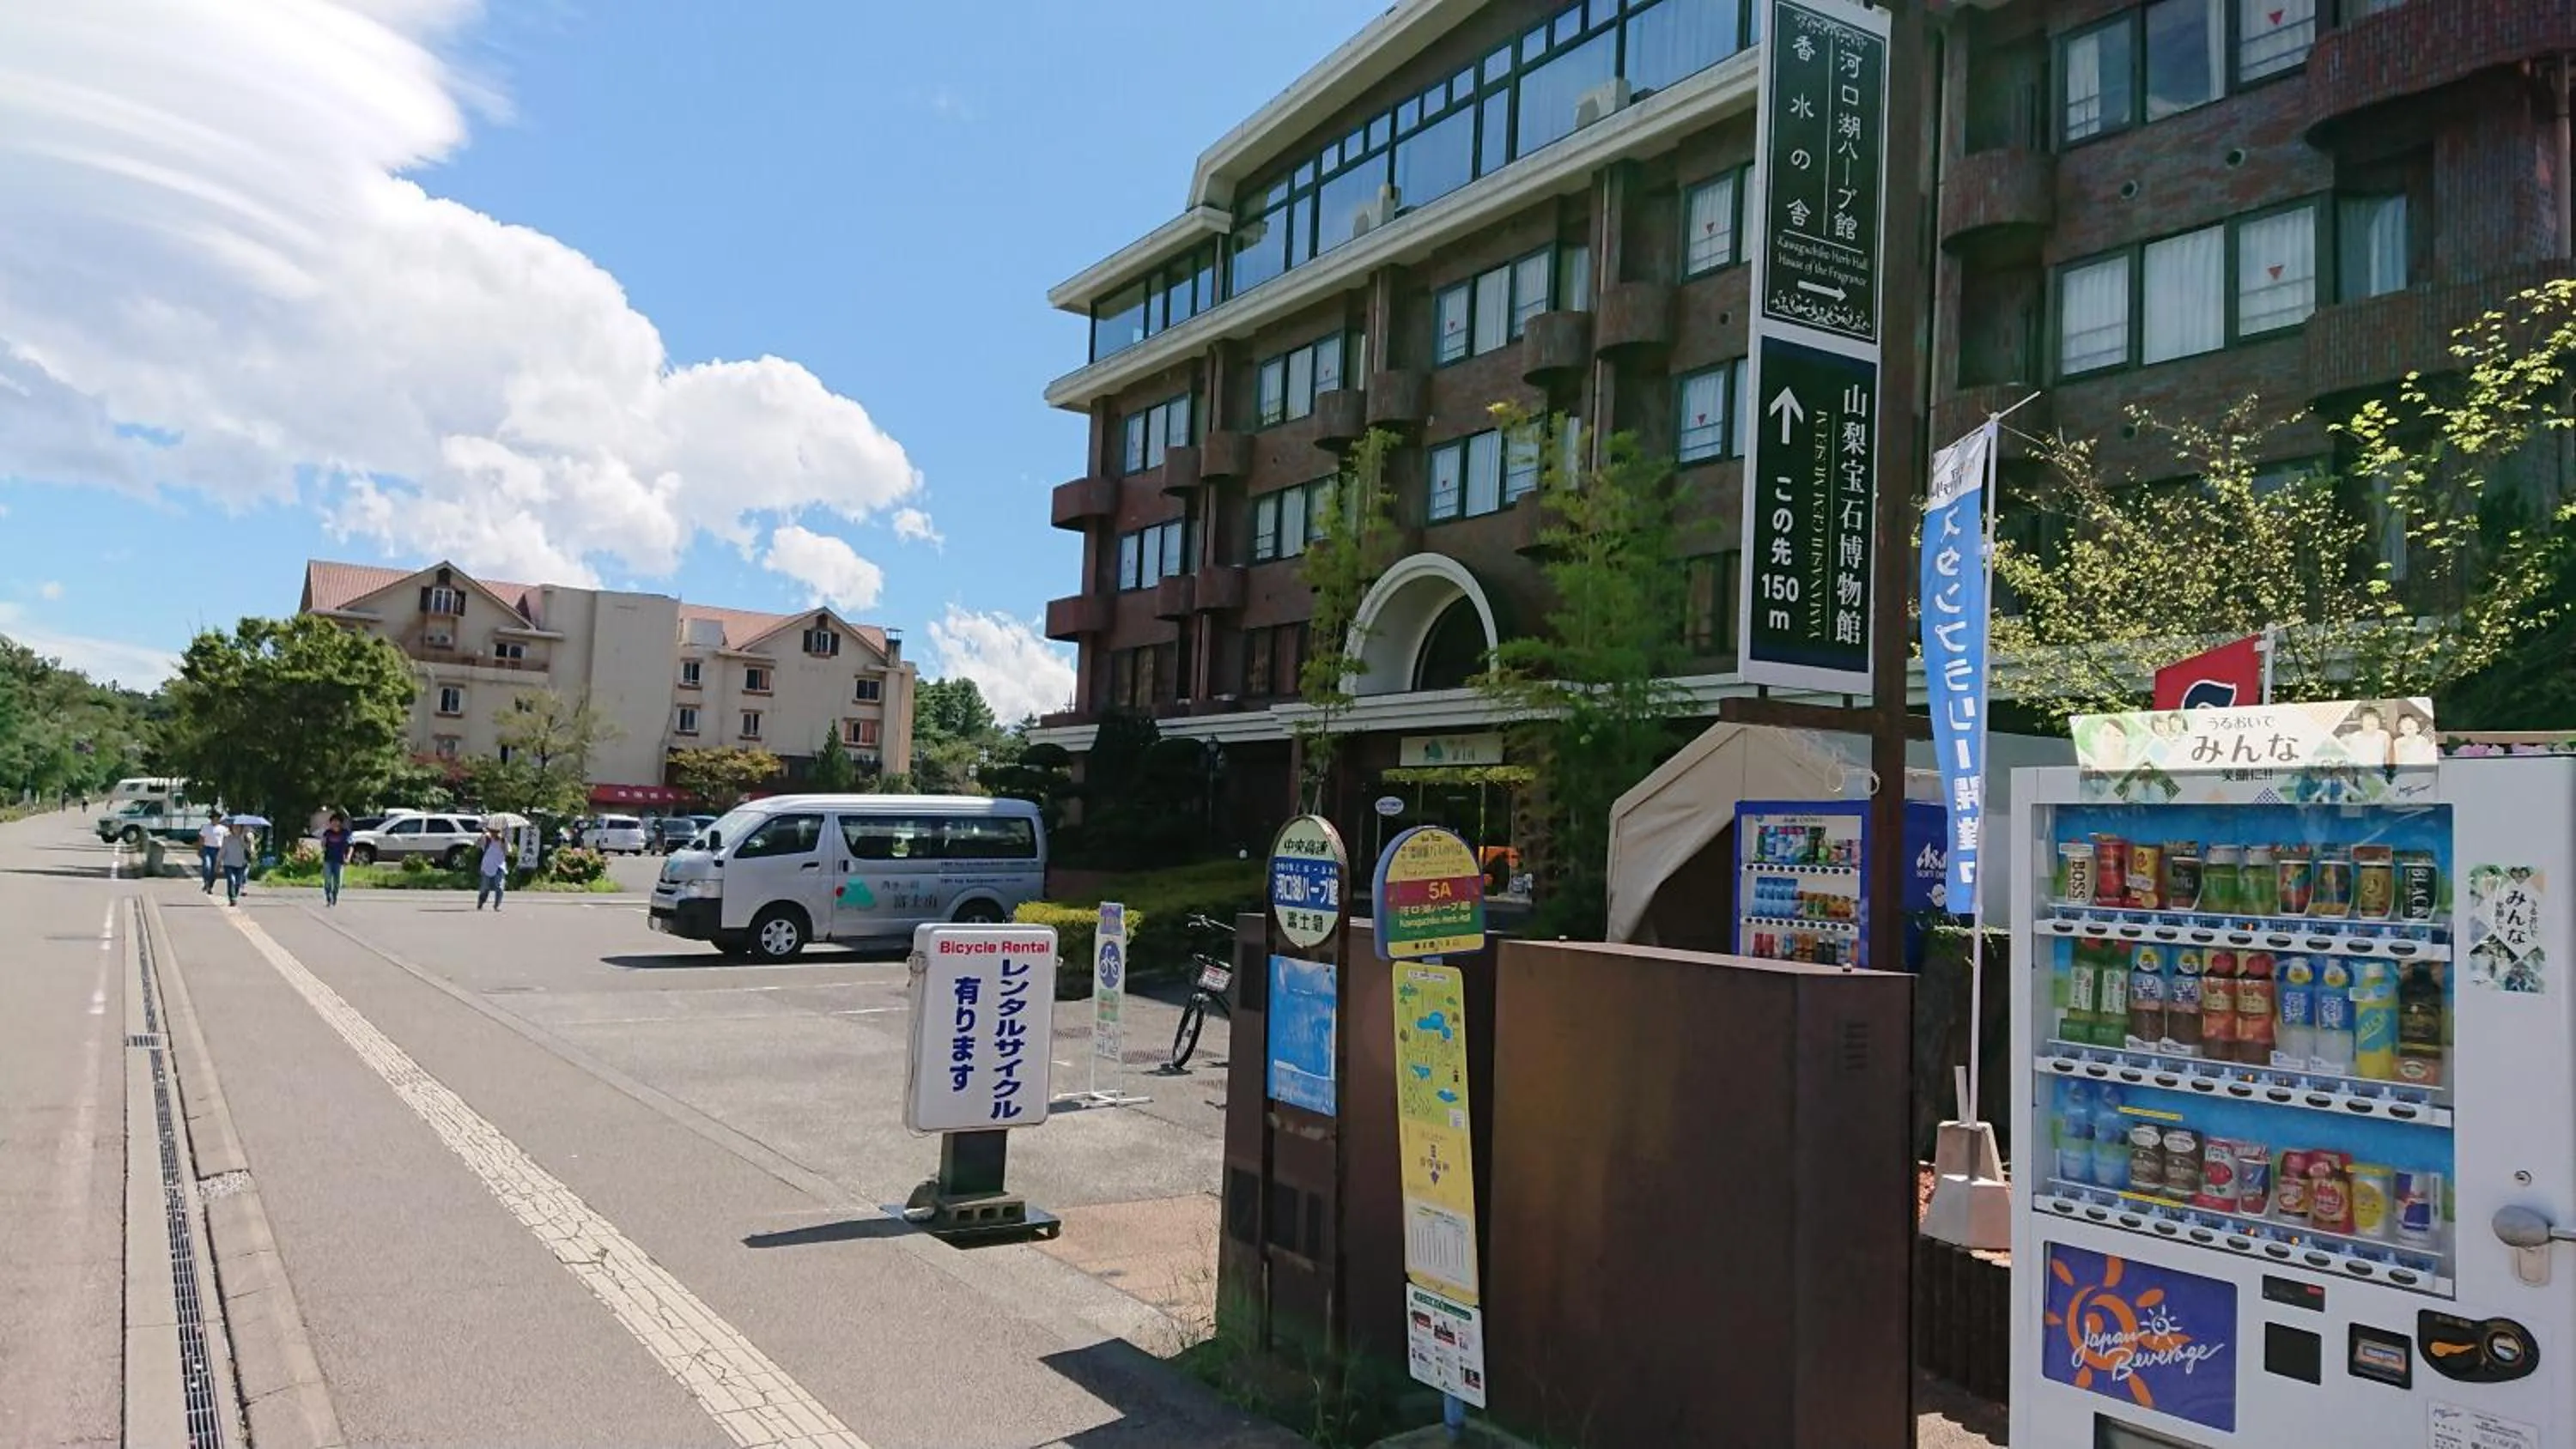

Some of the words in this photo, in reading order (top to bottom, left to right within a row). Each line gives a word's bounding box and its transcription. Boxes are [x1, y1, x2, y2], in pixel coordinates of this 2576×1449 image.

[1786, 34, 1816, 227] 香水の舎
[1834, 49, 1862, 241] 河口湖ハーブ館
[1778, 252, 1804, 270] House
[1814, 262, 1828, 275] the
[1836, 384, 1868, 646] 山梨宝石博物館
[2208, 714, 2276, 730] うるおいで
[2190, 733, 2301, 764] みんな
[1275, 872, 1340, 906] 河口湖ハーブ館
[1428, 881, 1452, 900] 5A
[2072, 860, 2087, 900] BOSS
[2411, 867, 2430, 919] BLACK
[2506, 889, 2527, 944] みんな
[939, 941, 997, 956] Bicycle
[1000, 941, 1050, 954] Rental
[949, 976, 981, 1093] 有ります
[990, 958, 1030, 1120] レンタルサイクル
[2071, 1321, 2151, 1368] Japan
[2104, 1343, 2226, 1381] Beverage
